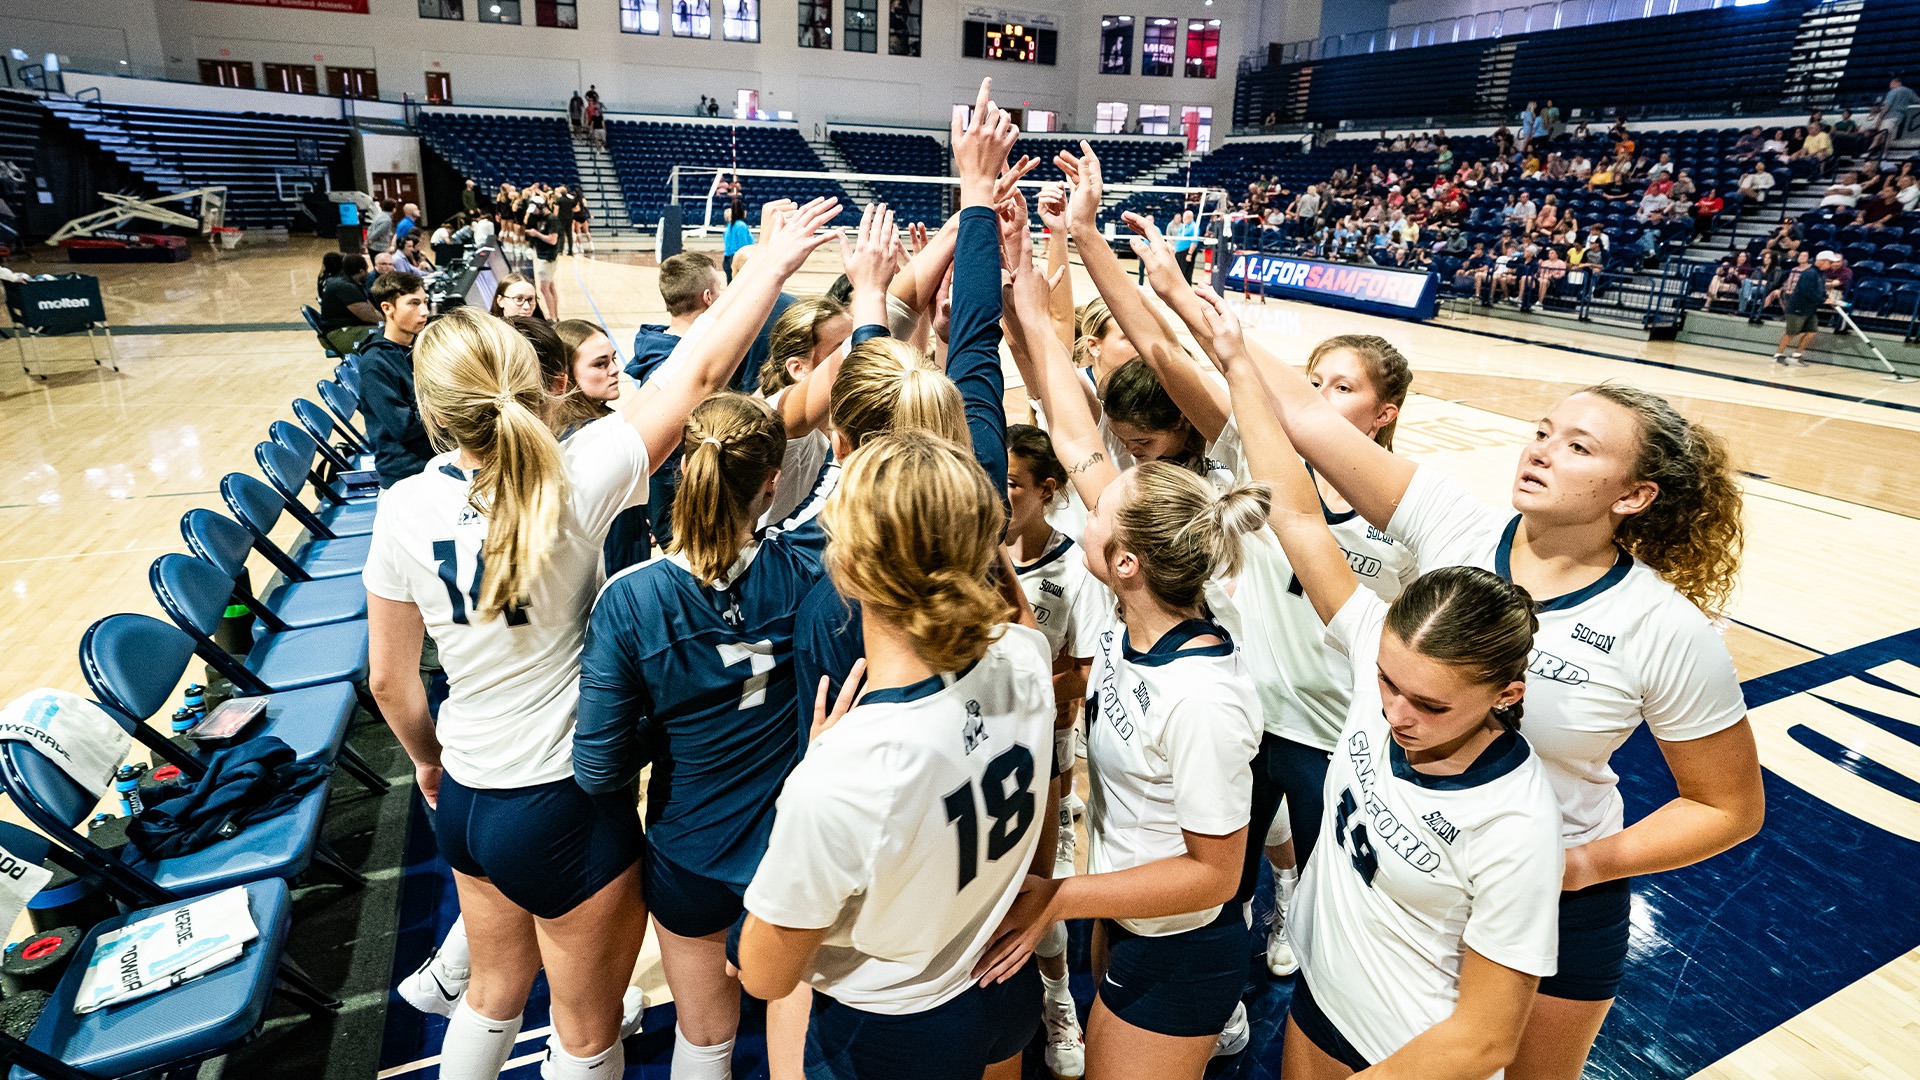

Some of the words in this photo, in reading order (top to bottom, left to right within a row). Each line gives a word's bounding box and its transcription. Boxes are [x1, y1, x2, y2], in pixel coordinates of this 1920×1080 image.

[38, 297, 90, 309] molten
[1039, 578, 1065, 598] SOCON
[1570, 622, 1616, 654] SOCON
[715, 638, 776, 711] 7
[940, 741, 1036, 896] 18
[1348, 730, 1441, 873] SAMFORD
[1421, 810, 1461, 846] SOCON
